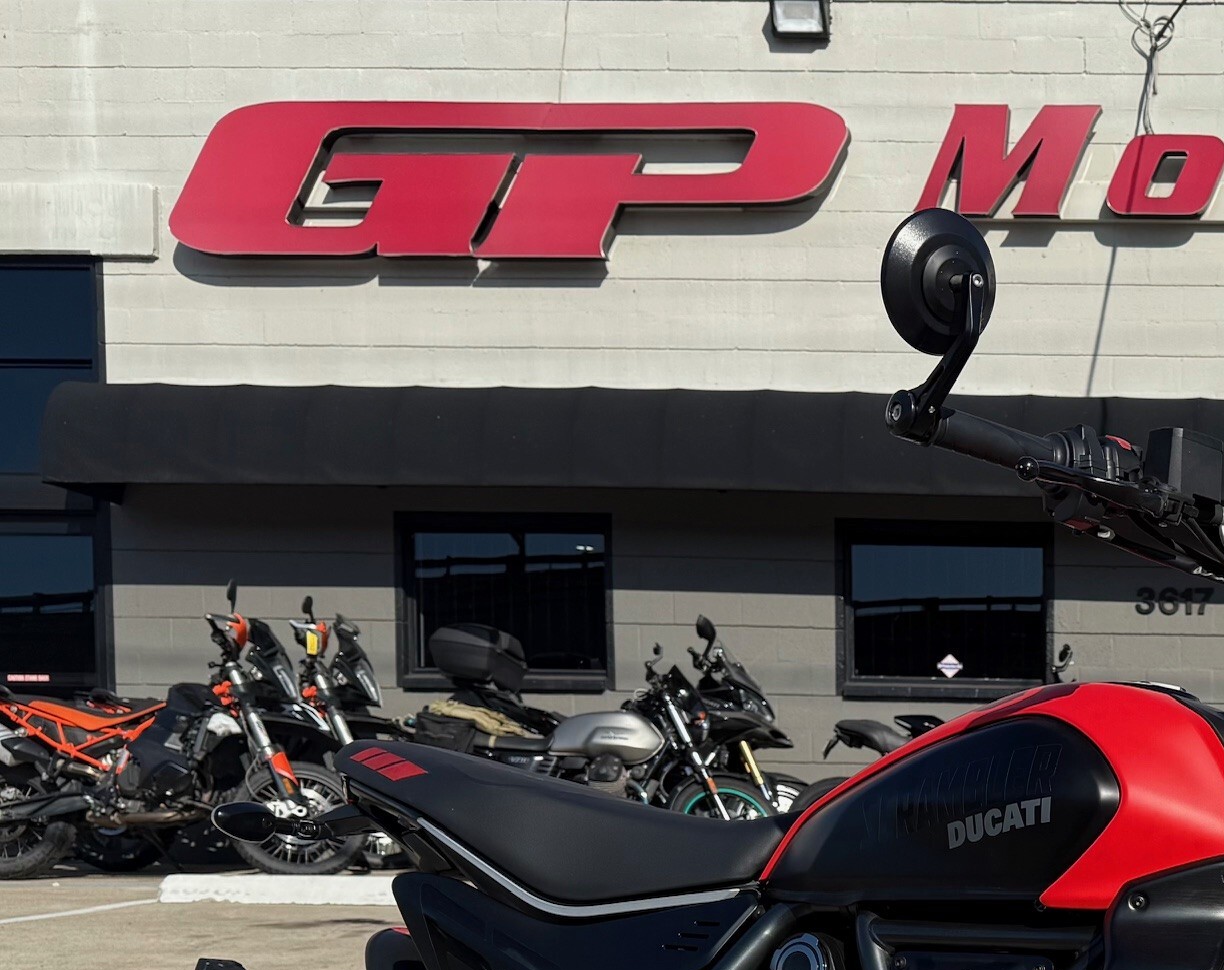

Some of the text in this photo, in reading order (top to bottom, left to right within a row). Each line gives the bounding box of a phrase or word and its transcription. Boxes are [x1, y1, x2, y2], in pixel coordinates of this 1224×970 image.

[169, 101, 852, 260] GP
[1135, 586, 1214, 615] 3617
[946, 796, 1053, 850] DUCATI
